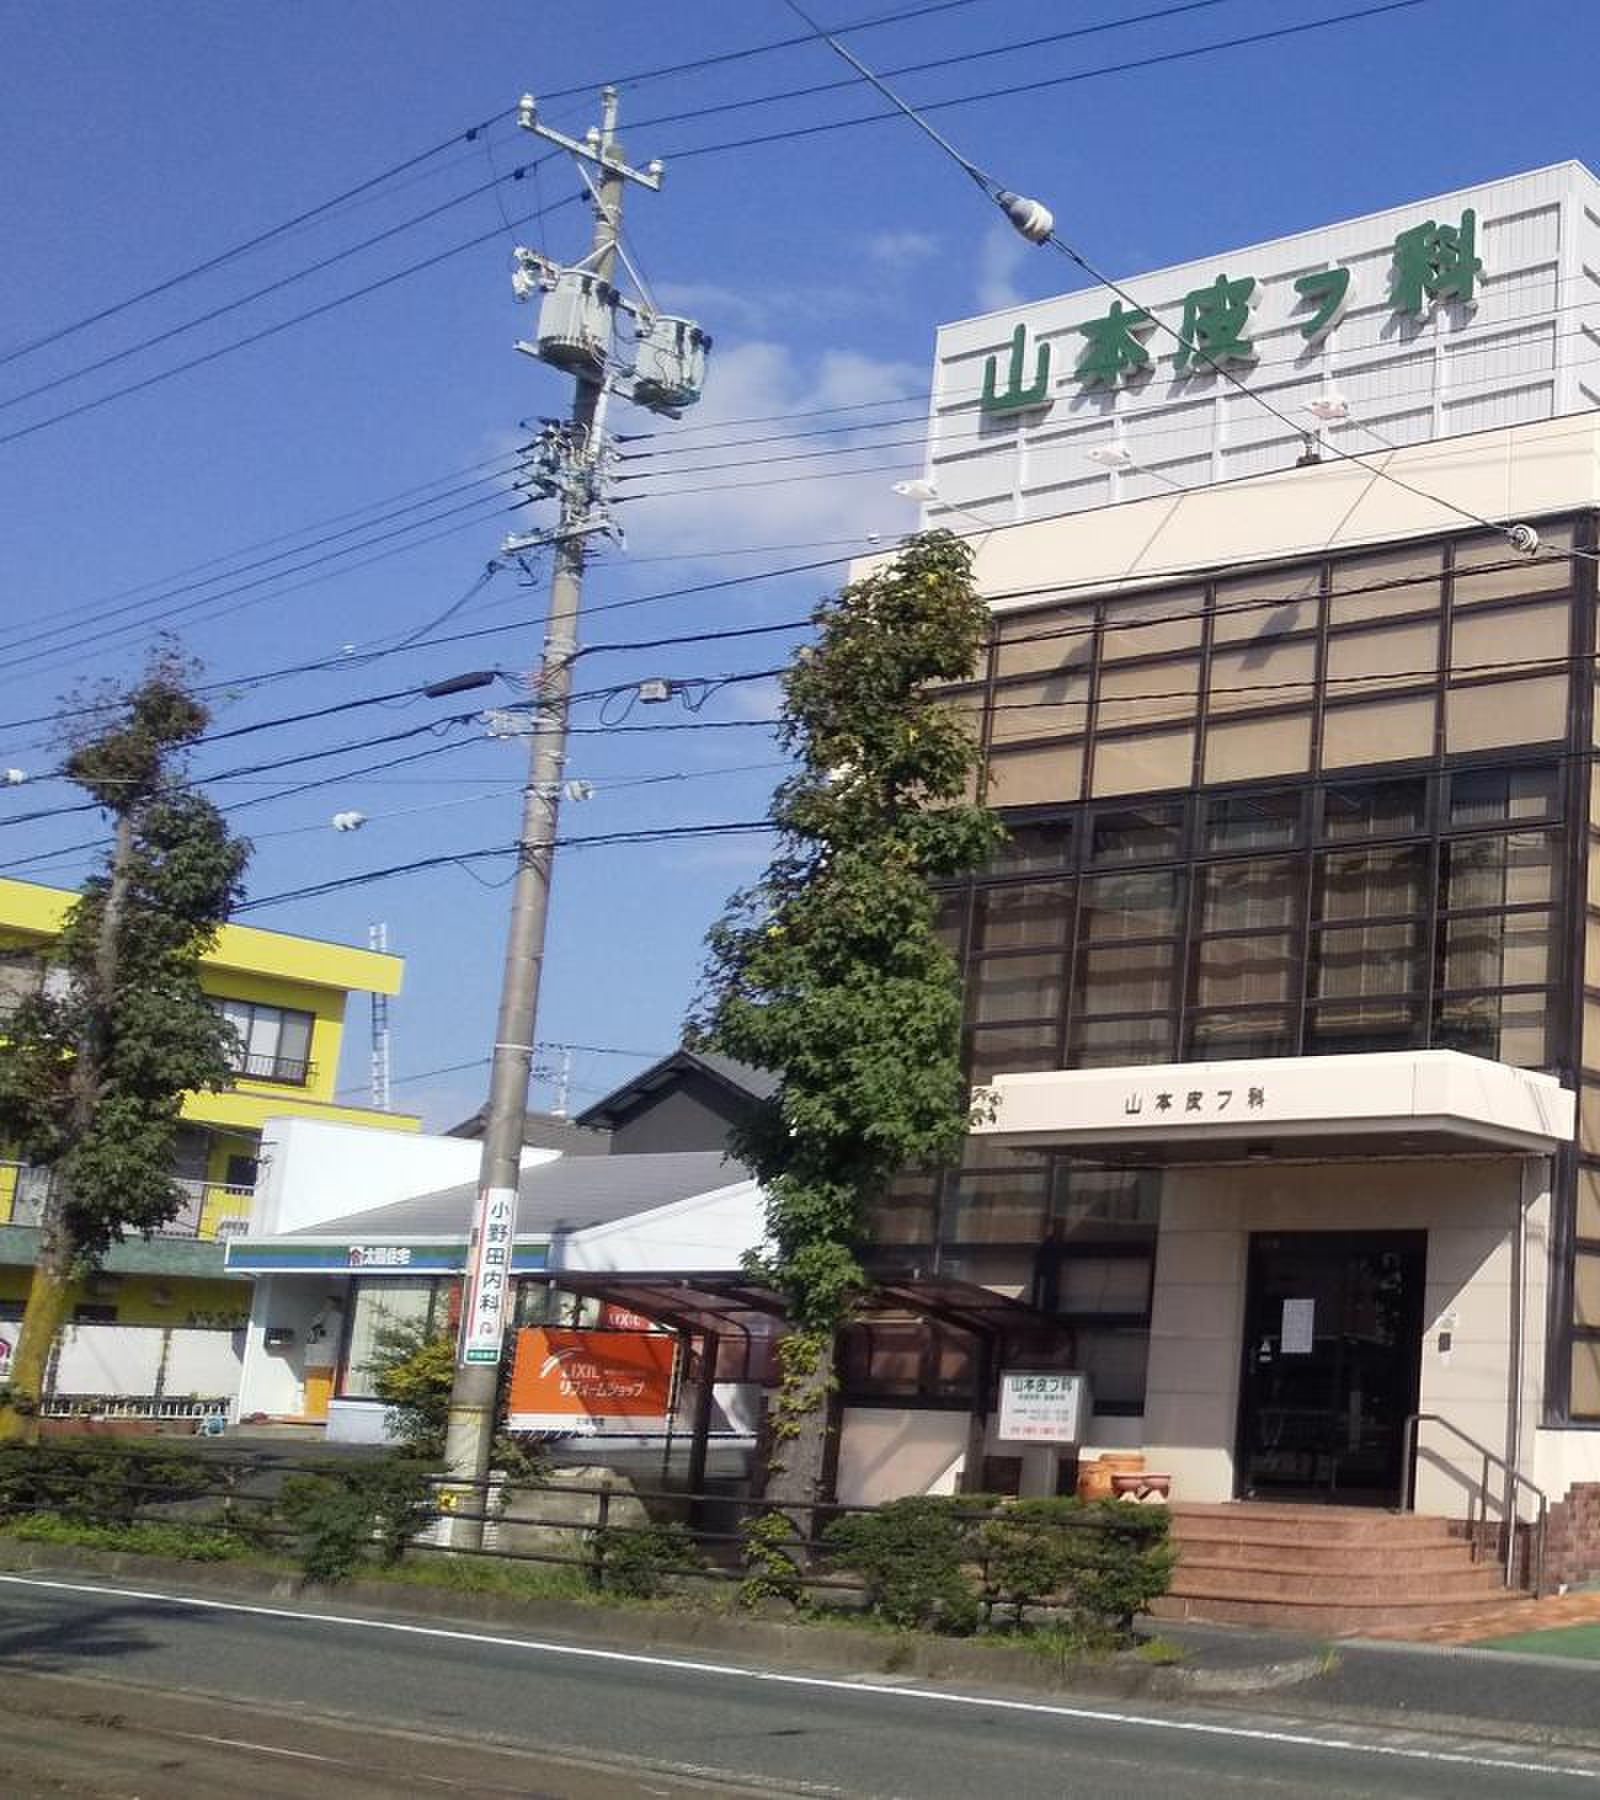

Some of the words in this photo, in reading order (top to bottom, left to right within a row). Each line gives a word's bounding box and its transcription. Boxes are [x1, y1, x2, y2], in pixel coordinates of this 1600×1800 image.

[982, 208, 1482, 416] 山本皮フ科
[1125, 1087, 1265, 1115] 山本皮フ科
[479, 1201, 510, 1313] 小野田内科
[561, 1363, 600, 1378] LIXIL
[560, 1380, 645, 1398] リフォームショップ
